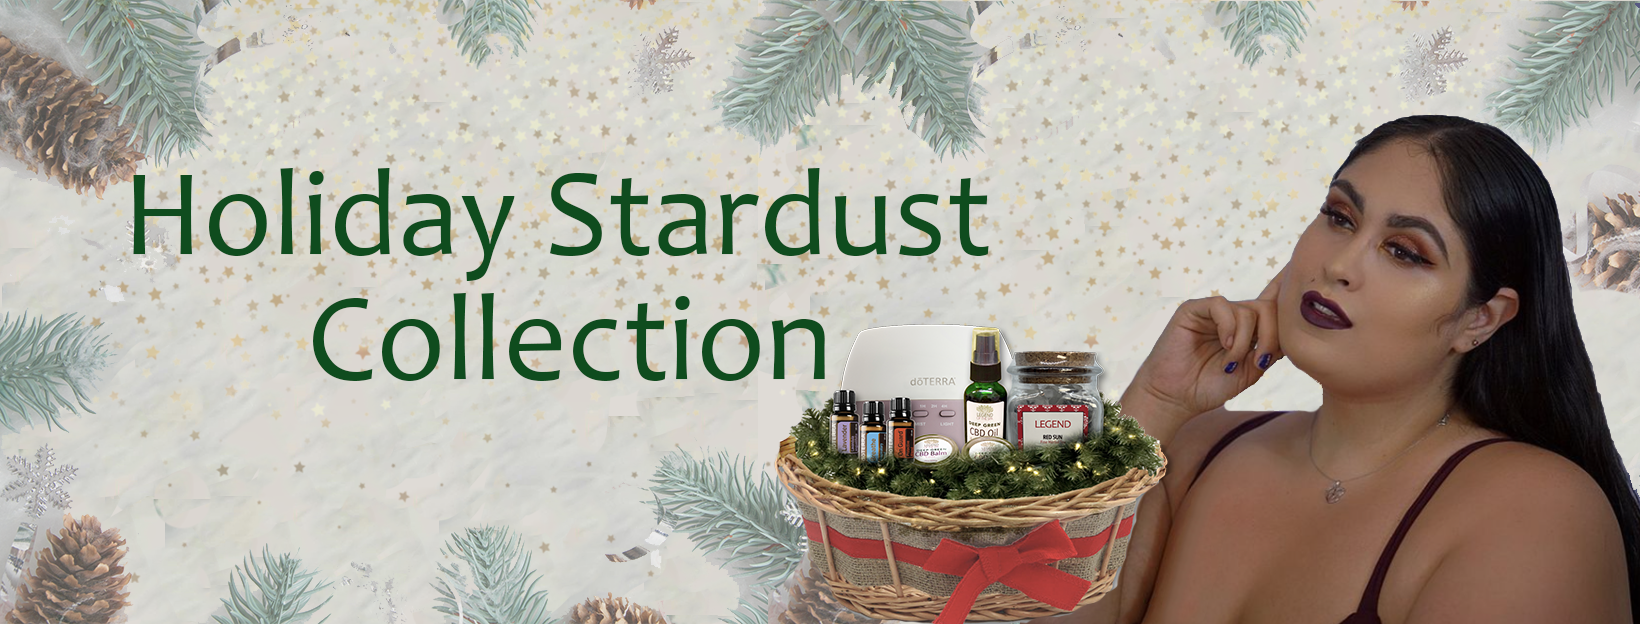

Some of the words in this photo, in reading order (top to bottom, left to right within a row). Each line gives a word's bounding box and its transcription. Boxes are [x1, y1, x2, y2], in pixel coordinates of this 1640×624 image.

[1035, 420, 1072, 429] LEGEND
[969, 427, 986, 437] CBD
[987, 428, 999, 437] Oil
[869, 438, 877, 462] Breathe
[897, 448, 904, 457] On
